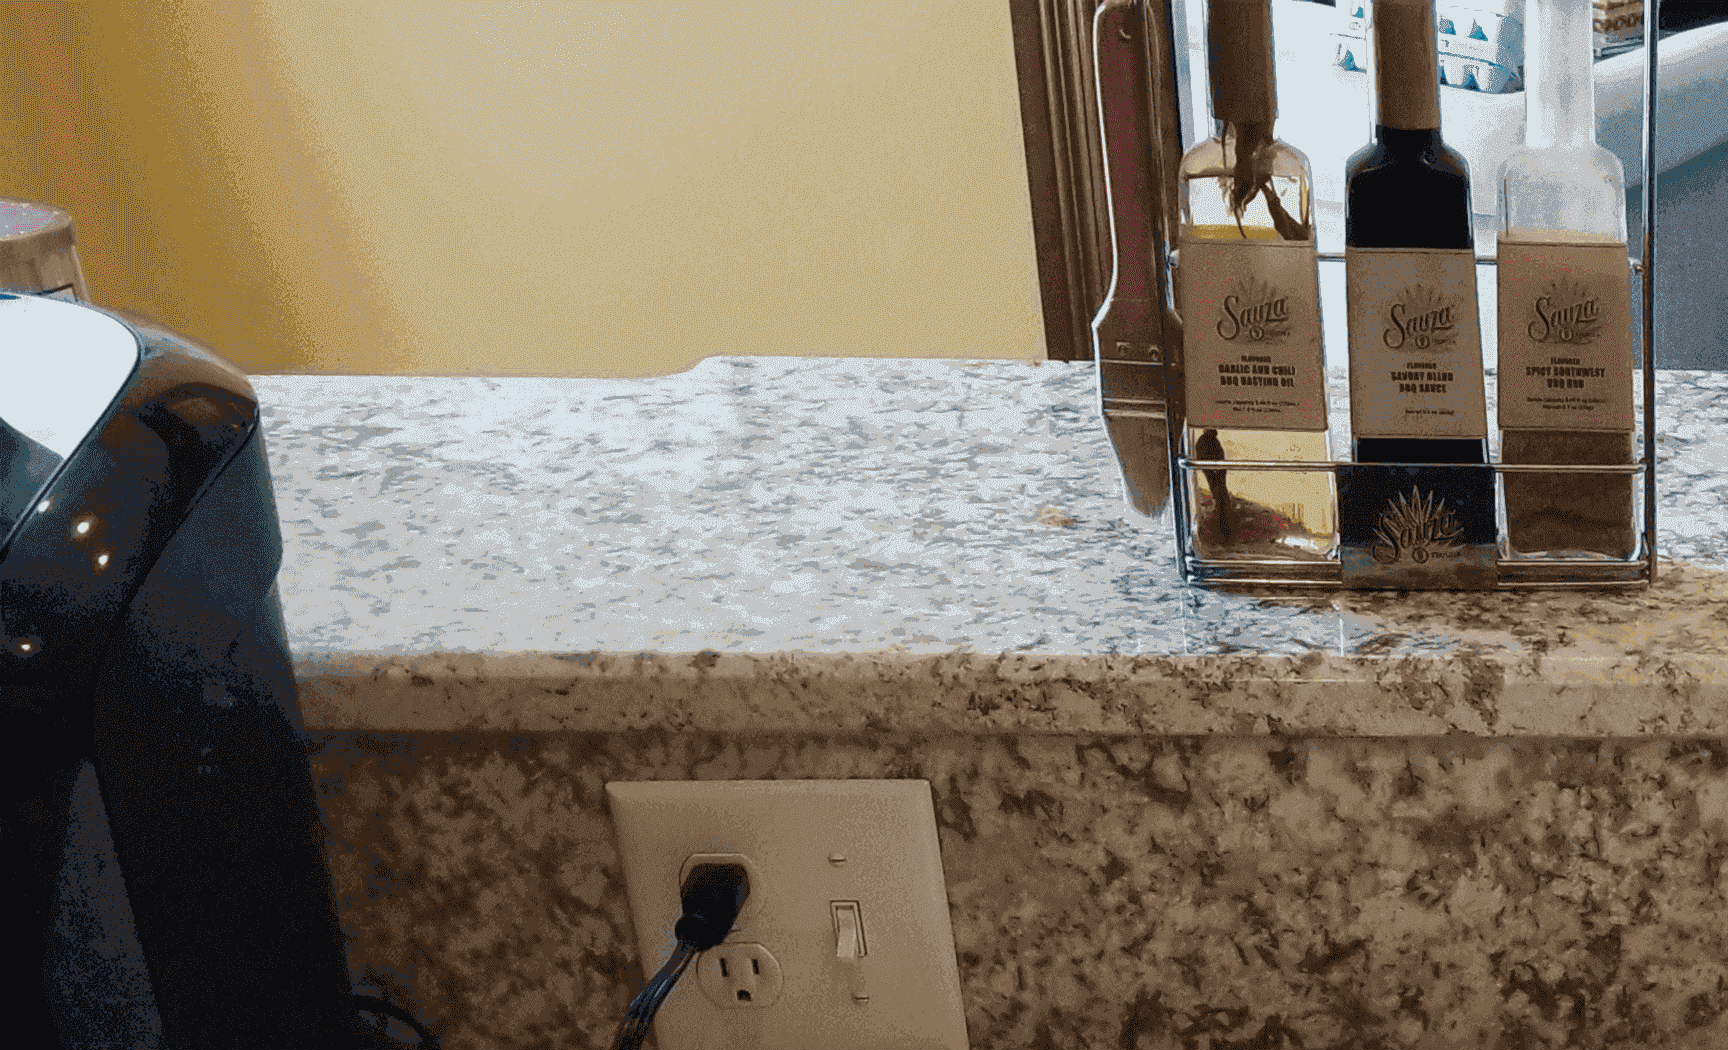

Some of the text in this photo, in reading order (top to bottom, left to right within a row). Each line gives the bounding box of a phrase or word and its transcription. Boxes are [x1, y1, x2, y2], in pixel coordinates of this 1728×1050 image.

[1217, 295, 1290, 340] Sauza
[1383, 303, 1455, 349] Sauza
[1528, 297, 1599, 342] Sauza
[1218, 364, 1296, 376] GARLIC AND CHILI
[1220, 376, 1295, 388] BBQ BASTING OIL
[1399, 383, 1447, 394] BBQ SAUCE
